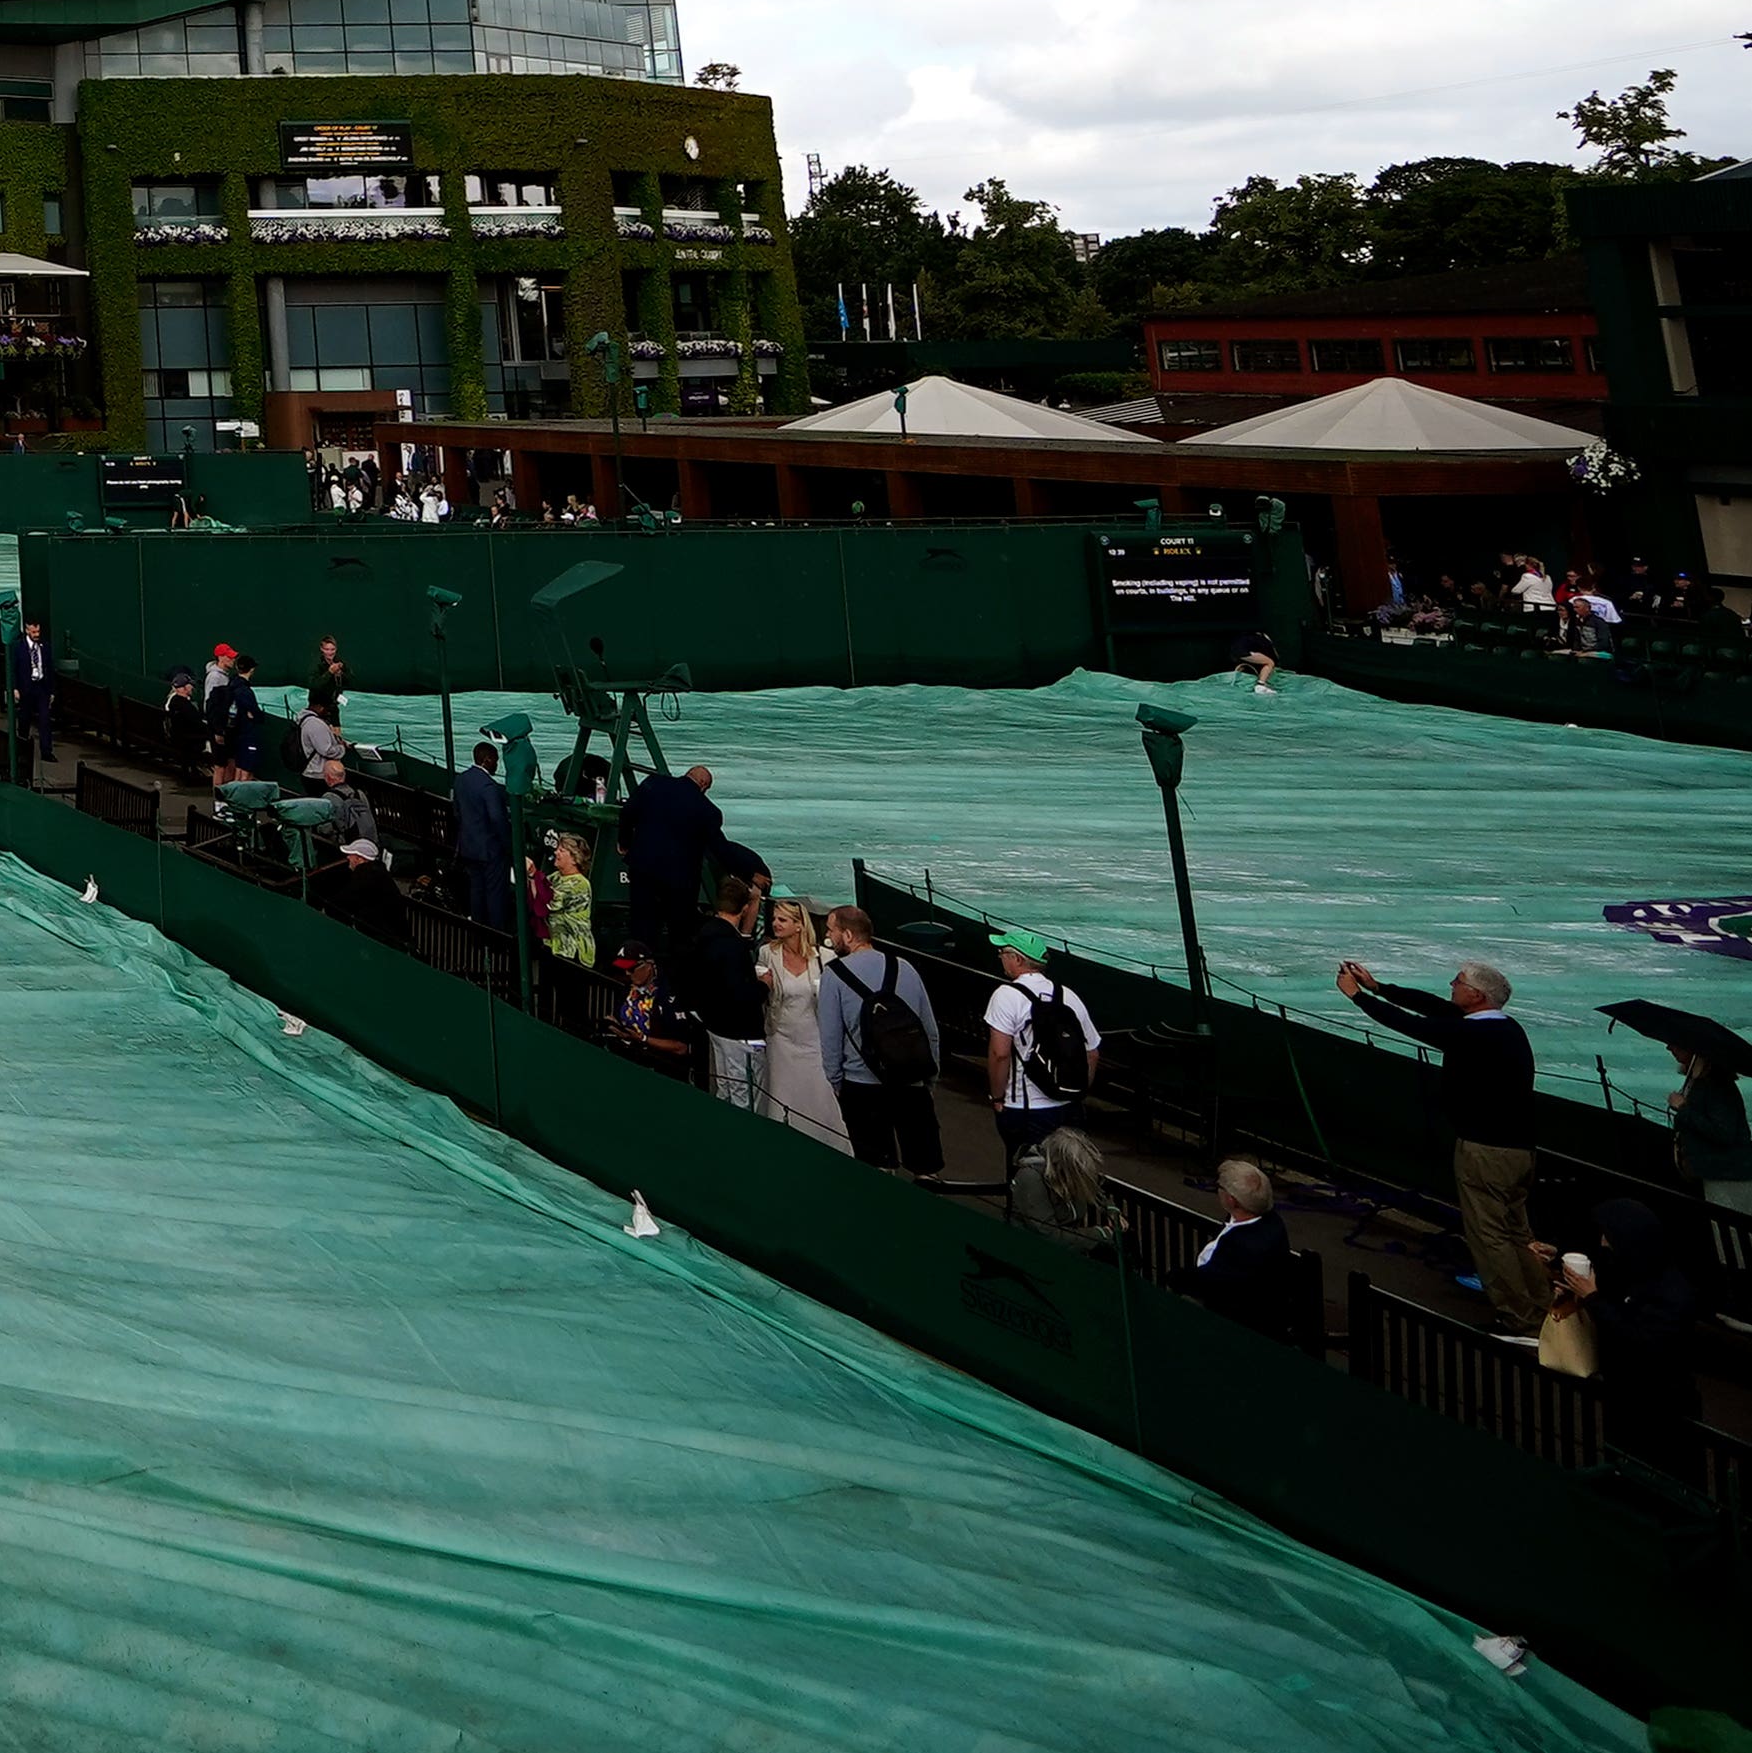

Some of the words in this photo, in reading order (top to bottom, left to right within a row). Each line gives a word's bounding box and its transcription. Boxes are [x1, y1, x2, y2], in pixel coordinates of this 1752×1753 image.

[1160, 537, 1186, 545] COURT
[1186, 537, 1195, 545] 11
[1163, 547, 1192, 555] ROLEX
[1111, 579, 1141, 587] Smoking
[1207, 579, 1218, 587] not
[959, 1276, 1073, 1352] Slazenger
